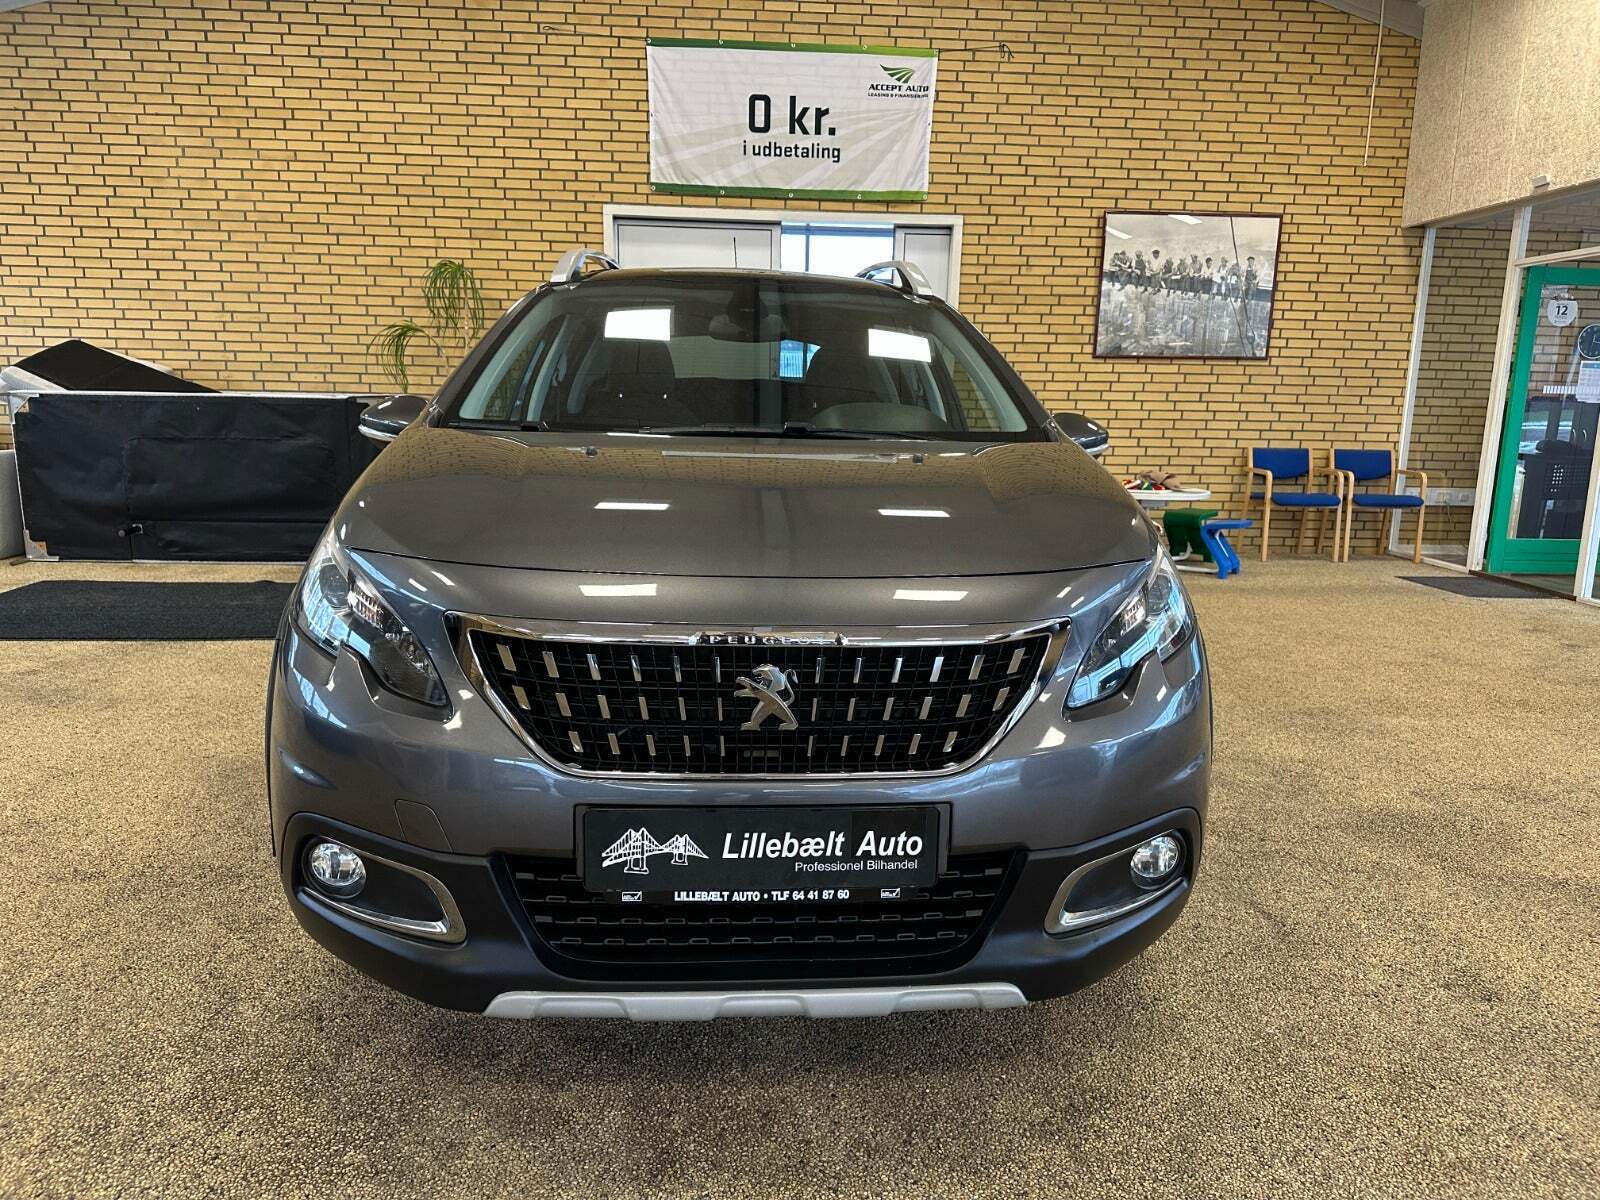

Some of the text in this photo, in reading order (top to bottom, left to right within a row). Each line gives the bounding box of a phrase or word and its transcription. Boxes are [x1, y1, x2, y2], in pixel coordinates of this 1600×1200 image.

[868, 83, 902, 92] ACCEPT
[748, 94, 836, 136] 0 kr.
[743, 140, 841, 163] i udbetaling
[1556, 305, 1568, 316] 12
[722, 830, 923, 859] Lillebælt Auto
[795, 859, 918, 872] Professionel Bilhandel
[674, 889, 850, 902] LILLEBÆLT AUTO TLF 64 41 87 60
